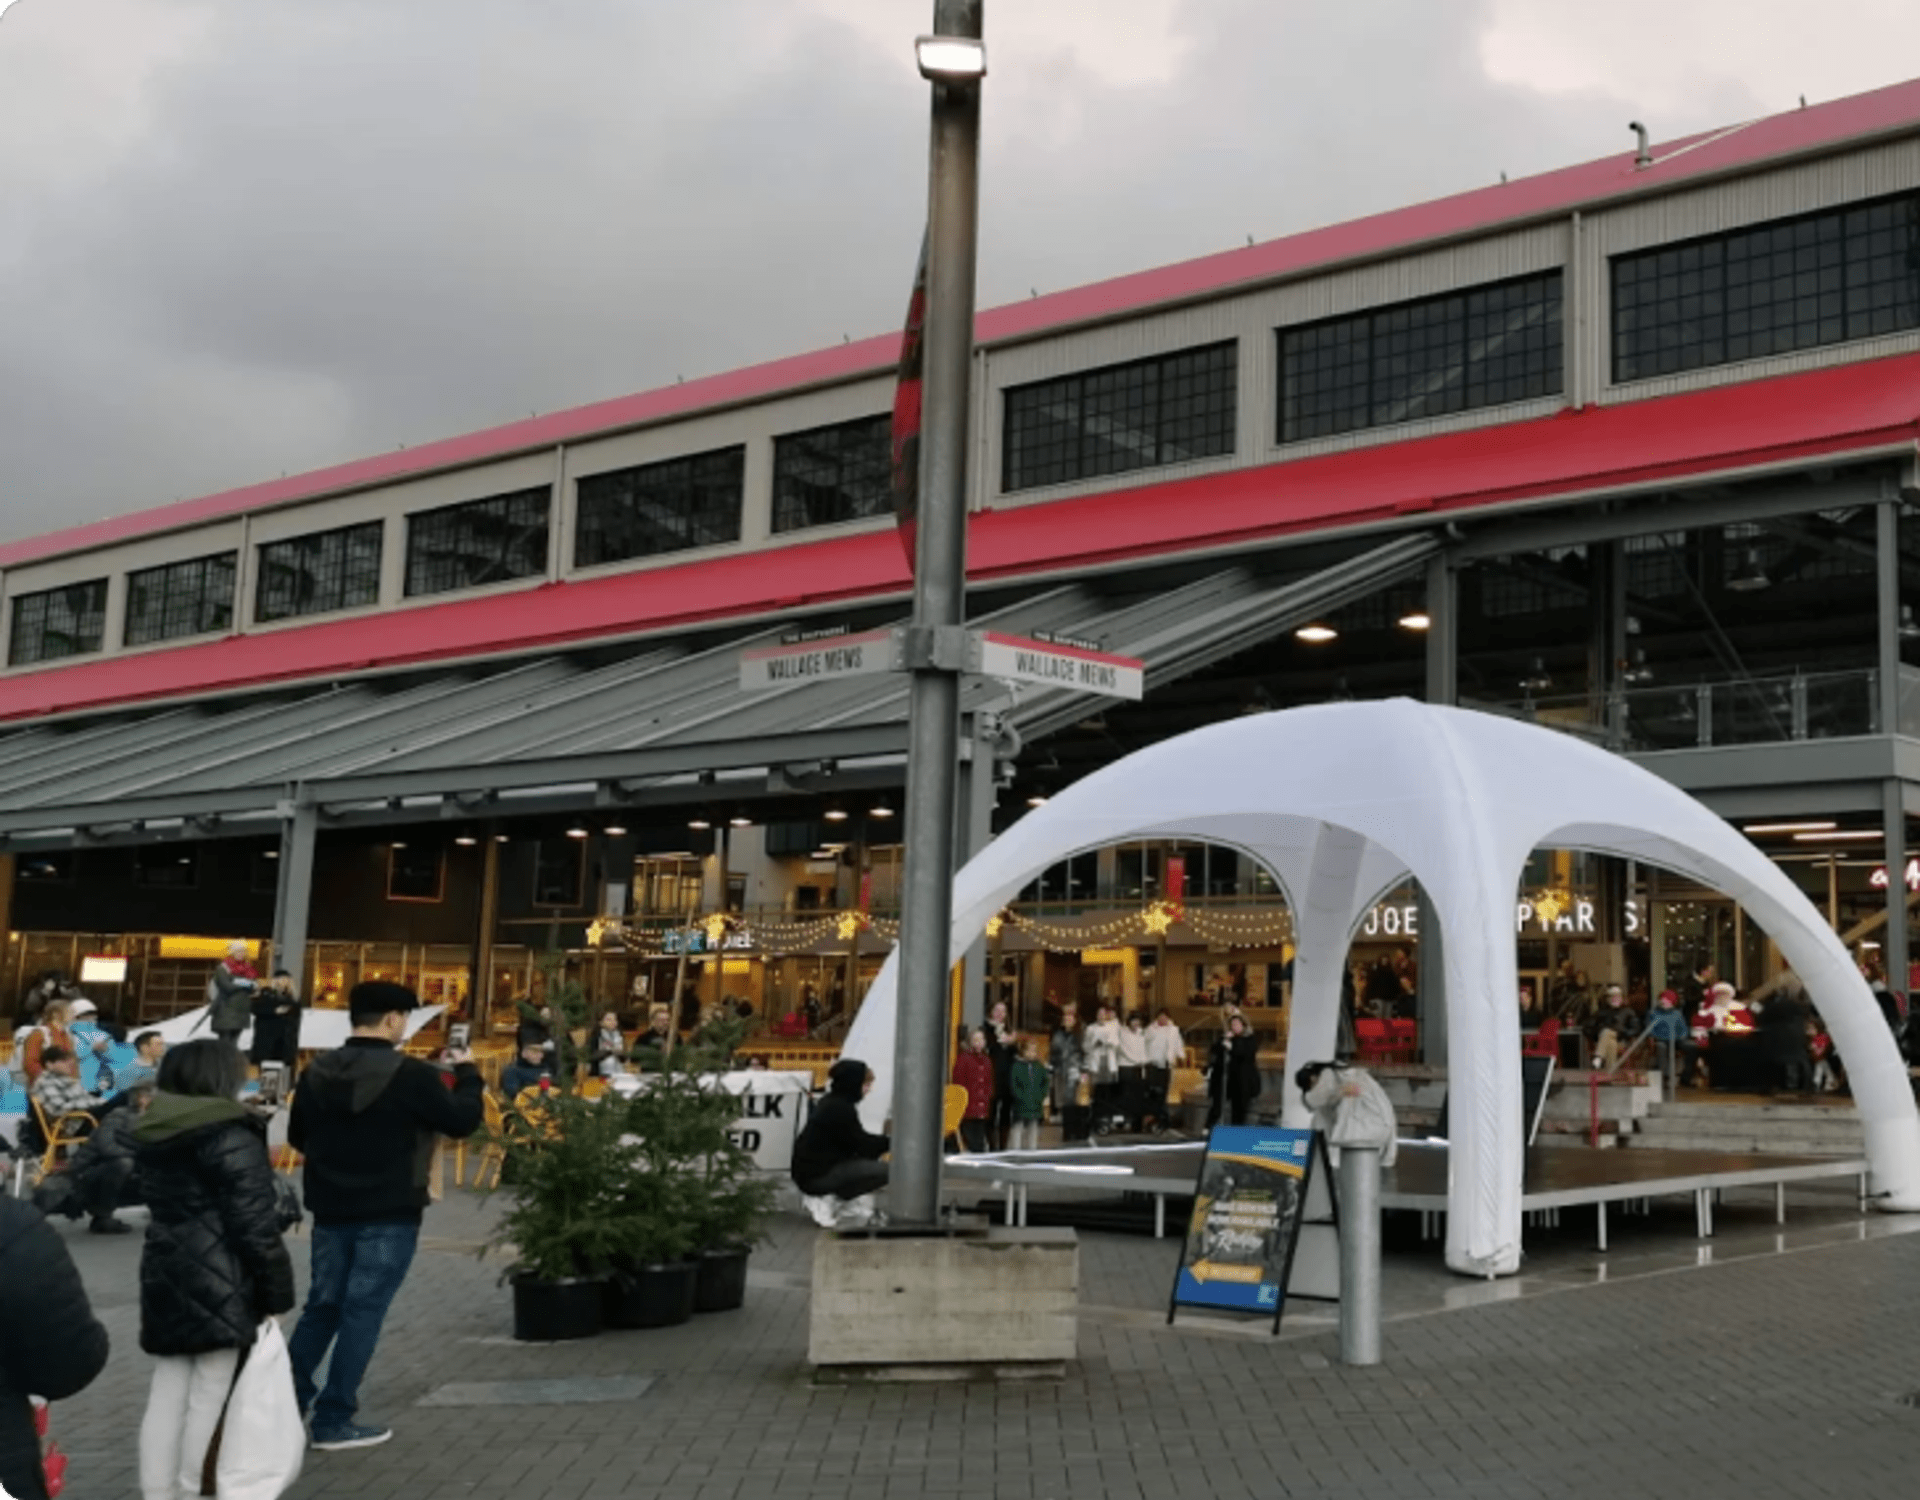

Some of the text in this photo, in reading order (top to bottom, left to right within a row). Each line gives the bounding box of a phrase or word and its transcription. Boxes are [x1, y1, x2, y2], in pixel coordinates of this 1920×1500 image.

[767, 645, 862, 681] WALLACE MEWS
[1016, 651, 1116, 690] WALLACE MEWS
